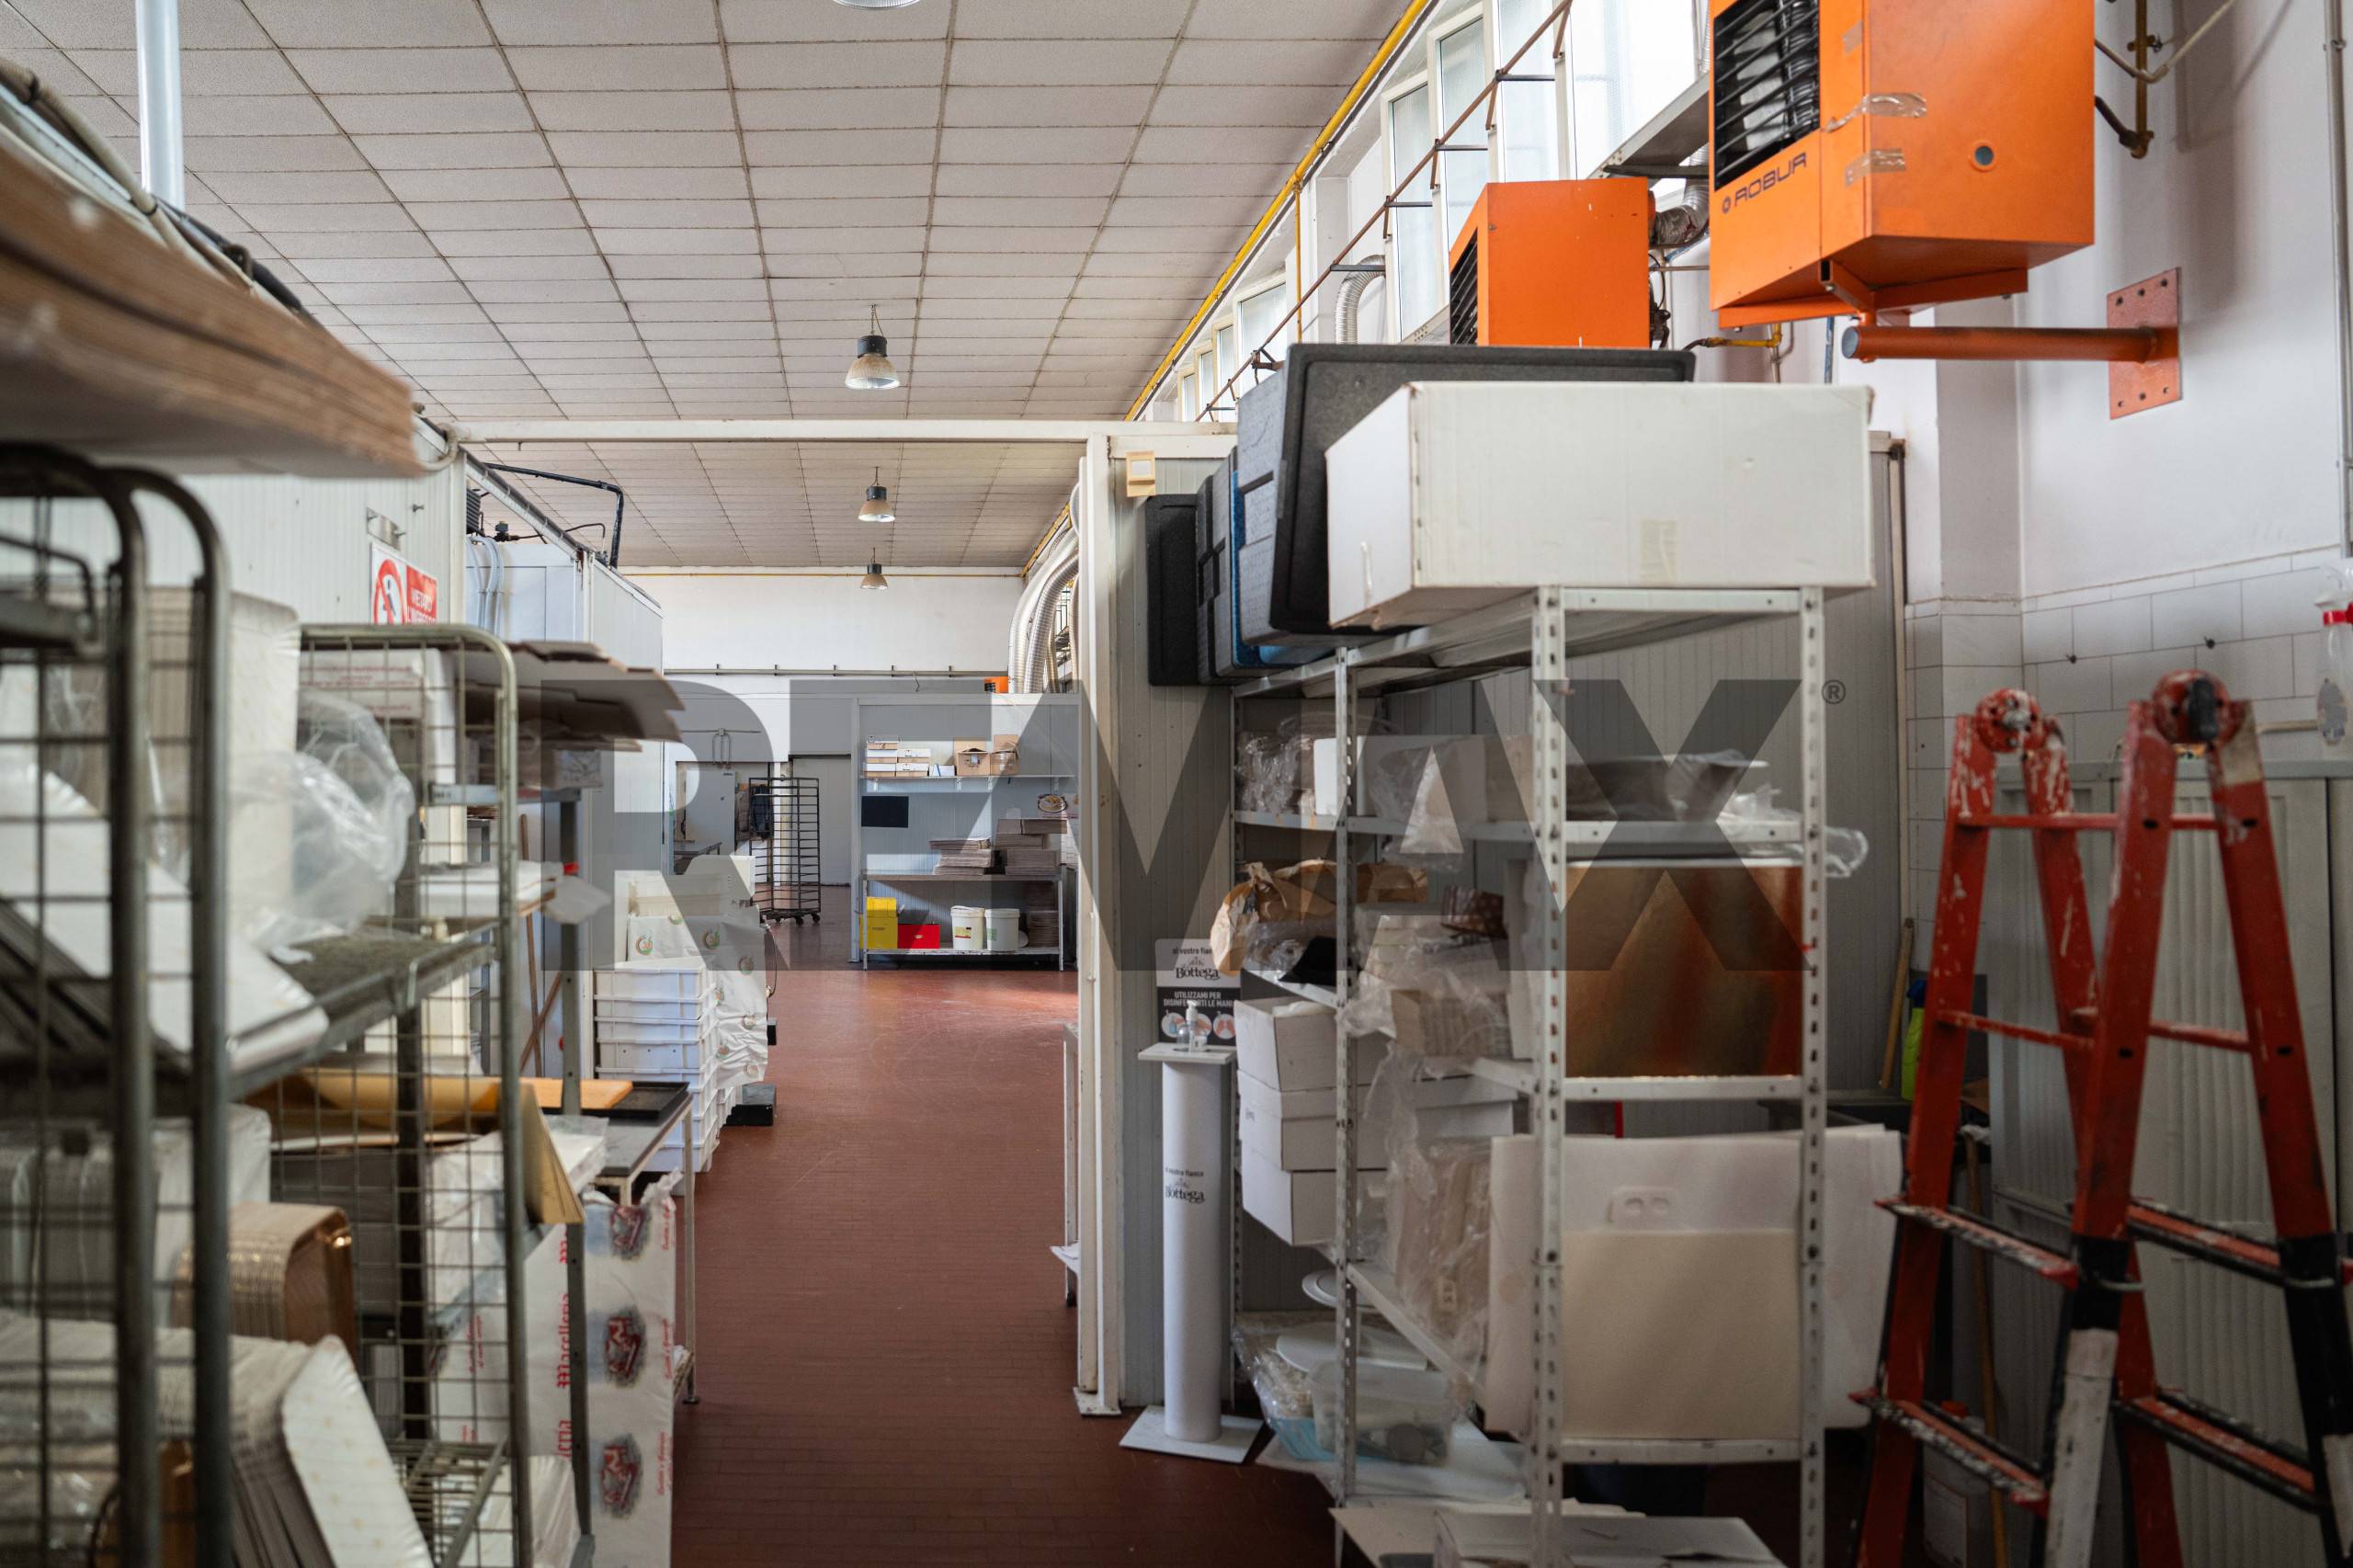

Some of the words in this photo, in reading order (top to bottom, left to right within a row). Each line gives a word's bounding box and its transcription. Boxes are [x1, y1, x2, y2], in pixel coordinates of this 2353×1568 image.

[1734, 151, 1807, 207] ROBUR
[1200, 947, 1213, 955] fian
[1176, 966, 1221, 981] Bottega
[1174, 991, 1209, 999] UTILIZZAMI
[1209, 992, 1222, 1000] PER
[1163, 998, 1208, 1007] DISINFERTI
[1208, 1000, 1216, 1008] LE
